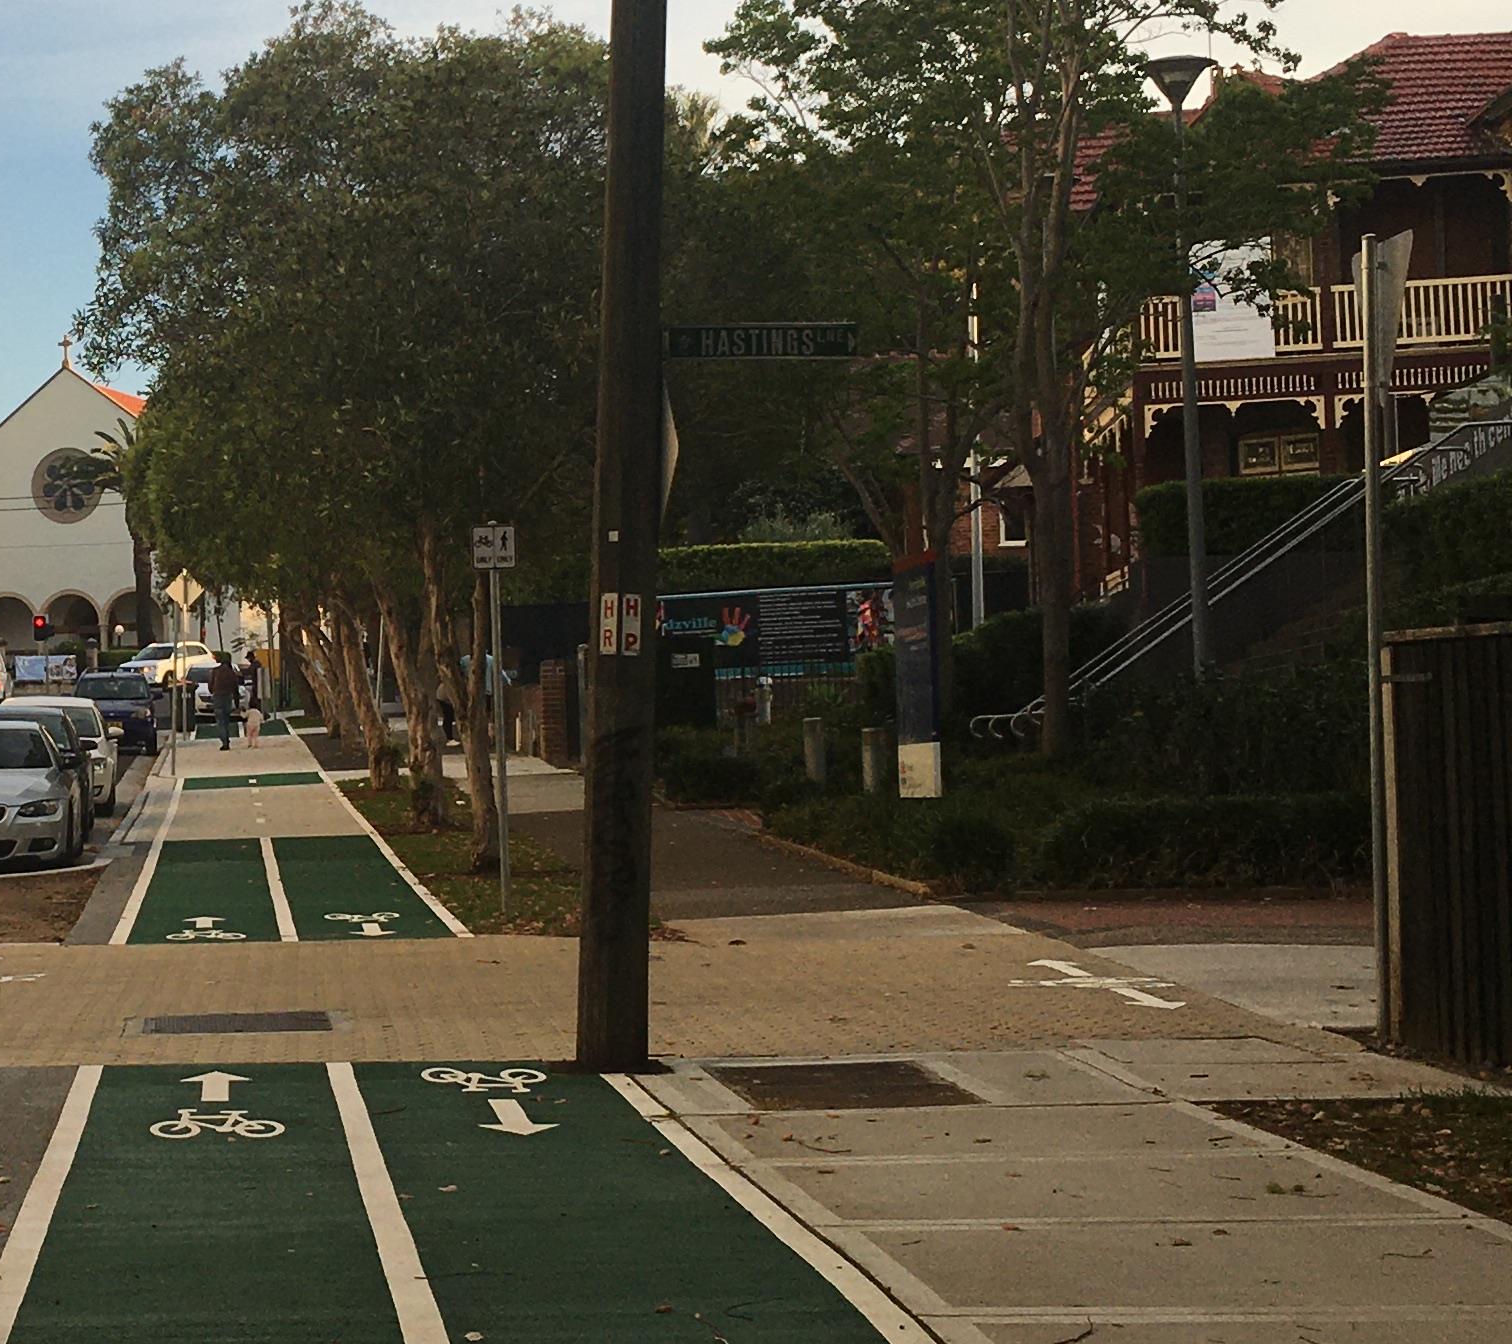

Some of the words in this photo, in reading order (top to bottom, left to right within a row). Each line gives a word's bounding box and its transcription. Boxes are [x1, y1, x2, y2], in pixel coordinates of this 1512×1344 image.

[700, 329, 814, 356] HASTINGS
[1449, 427, 1487, 475] heath
[664, 616, 718, 630] dzville
